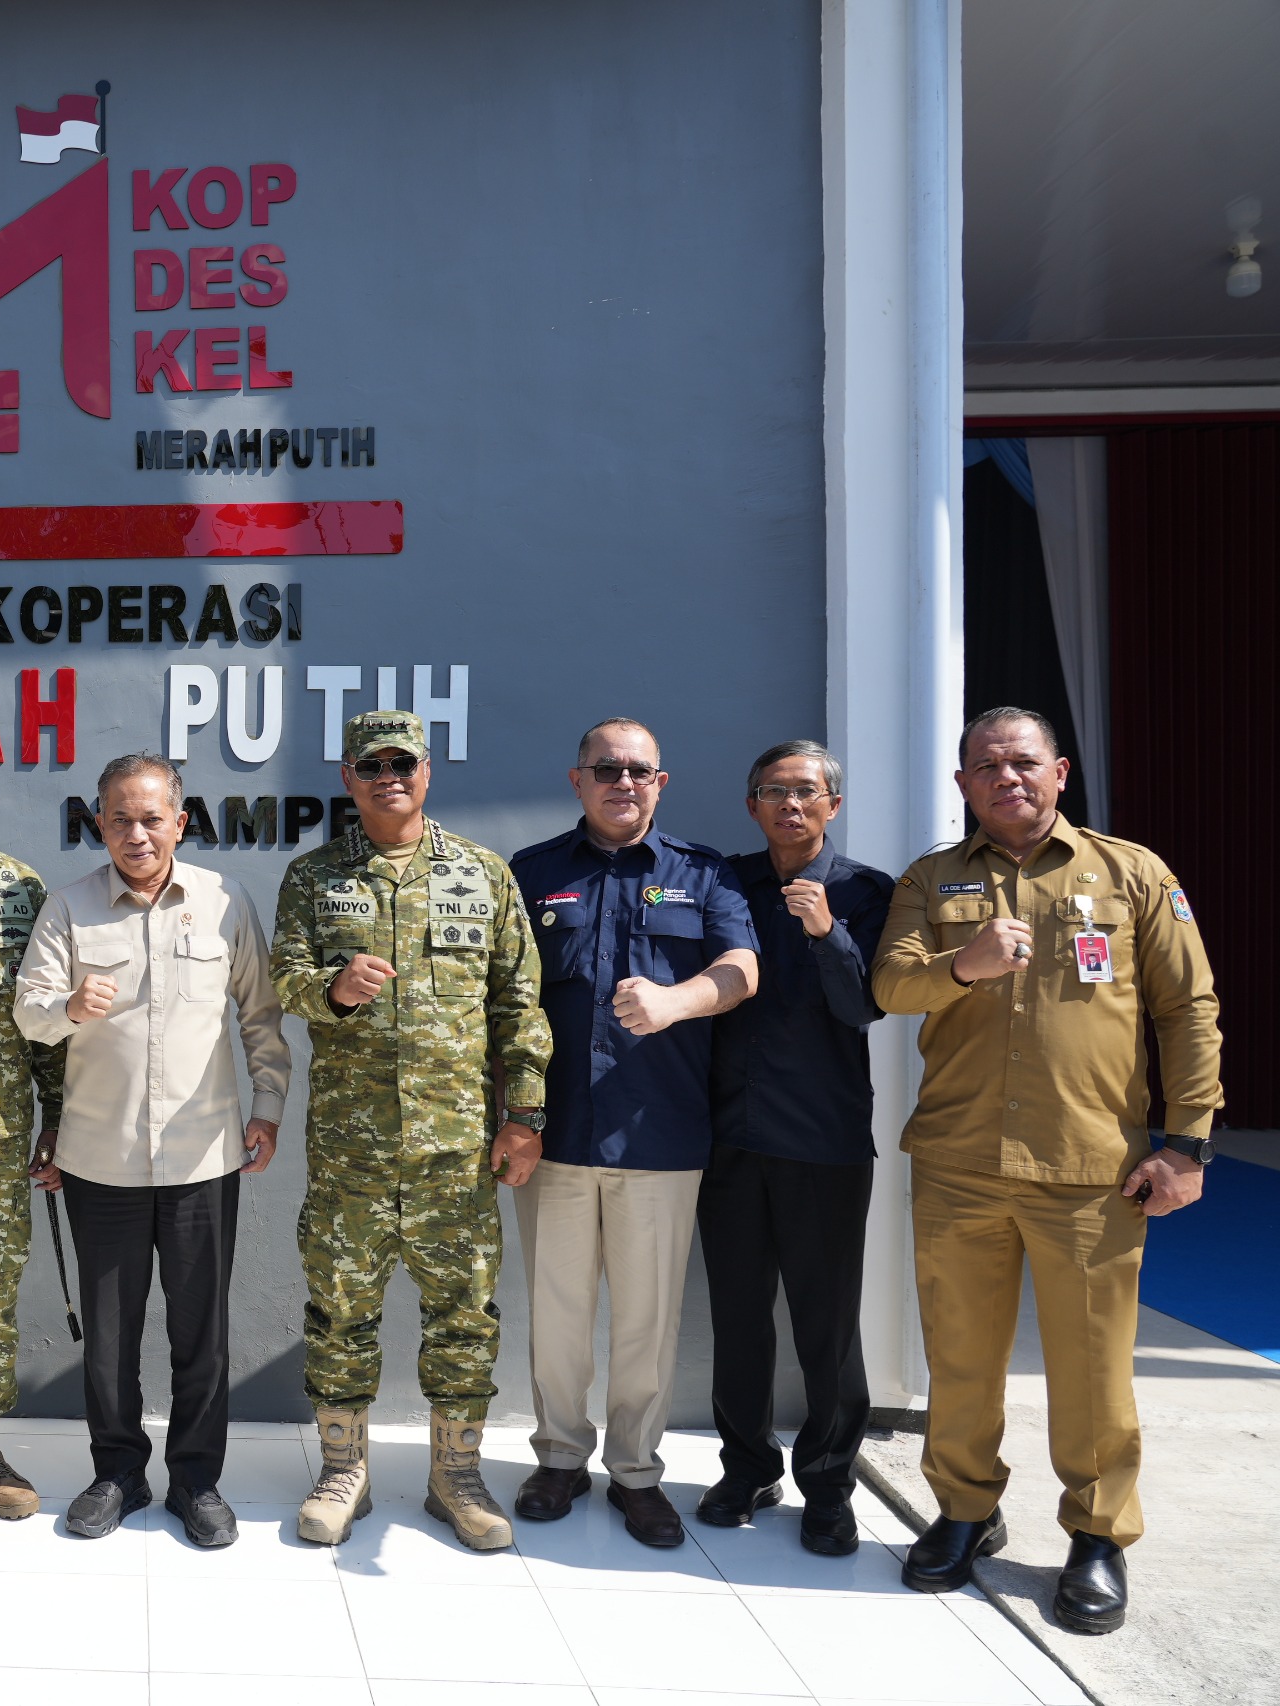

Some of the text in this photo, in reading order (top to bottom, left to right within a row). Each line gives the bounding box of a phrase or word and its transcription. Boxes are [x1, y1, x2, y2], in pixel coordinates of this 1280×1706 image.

[132, 163, 297, 231] KOP
[134, 243, 288, 311] DES
[135, 326, 293, 393] KEL
[13, 905, 29, 915] AD
[317, 900, 370, 914] TANDYO
[435, 902, 489, 915] TNI AD
